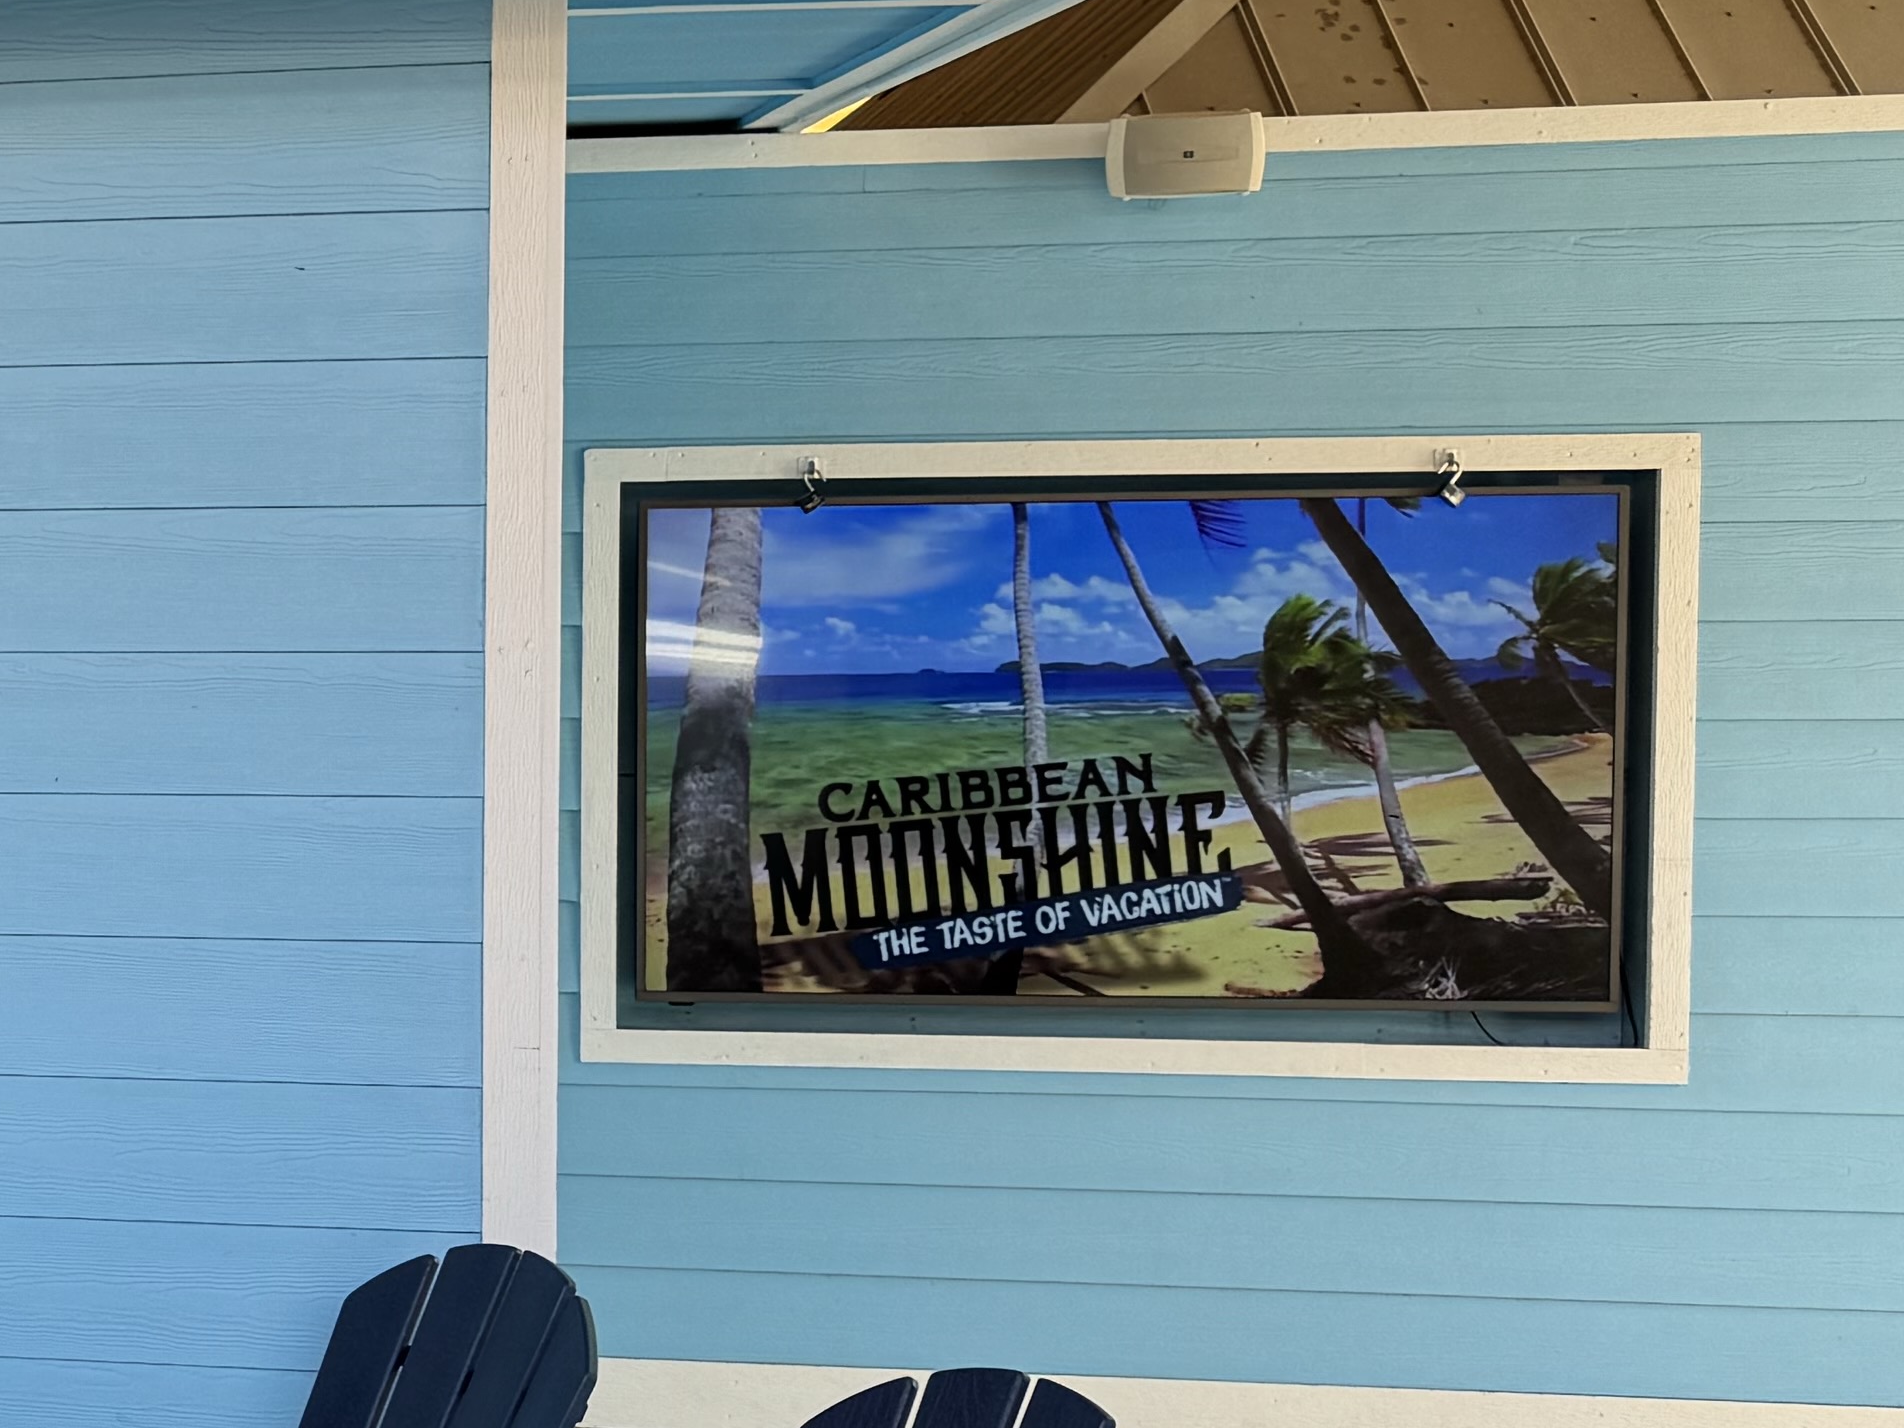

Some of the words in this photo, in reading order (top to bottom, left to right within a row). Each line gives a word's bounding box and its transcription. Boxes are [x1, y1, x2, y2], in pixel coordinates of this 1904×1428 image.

[817, 752, 1157, 823] CARIBBEAN
[759, 790, 1233, 937] MOONSHINE
[872, 925, 930, 963] THE
[935, 910, 1025, 951] TASTE
[1035, 900, 1072, 935] OF
